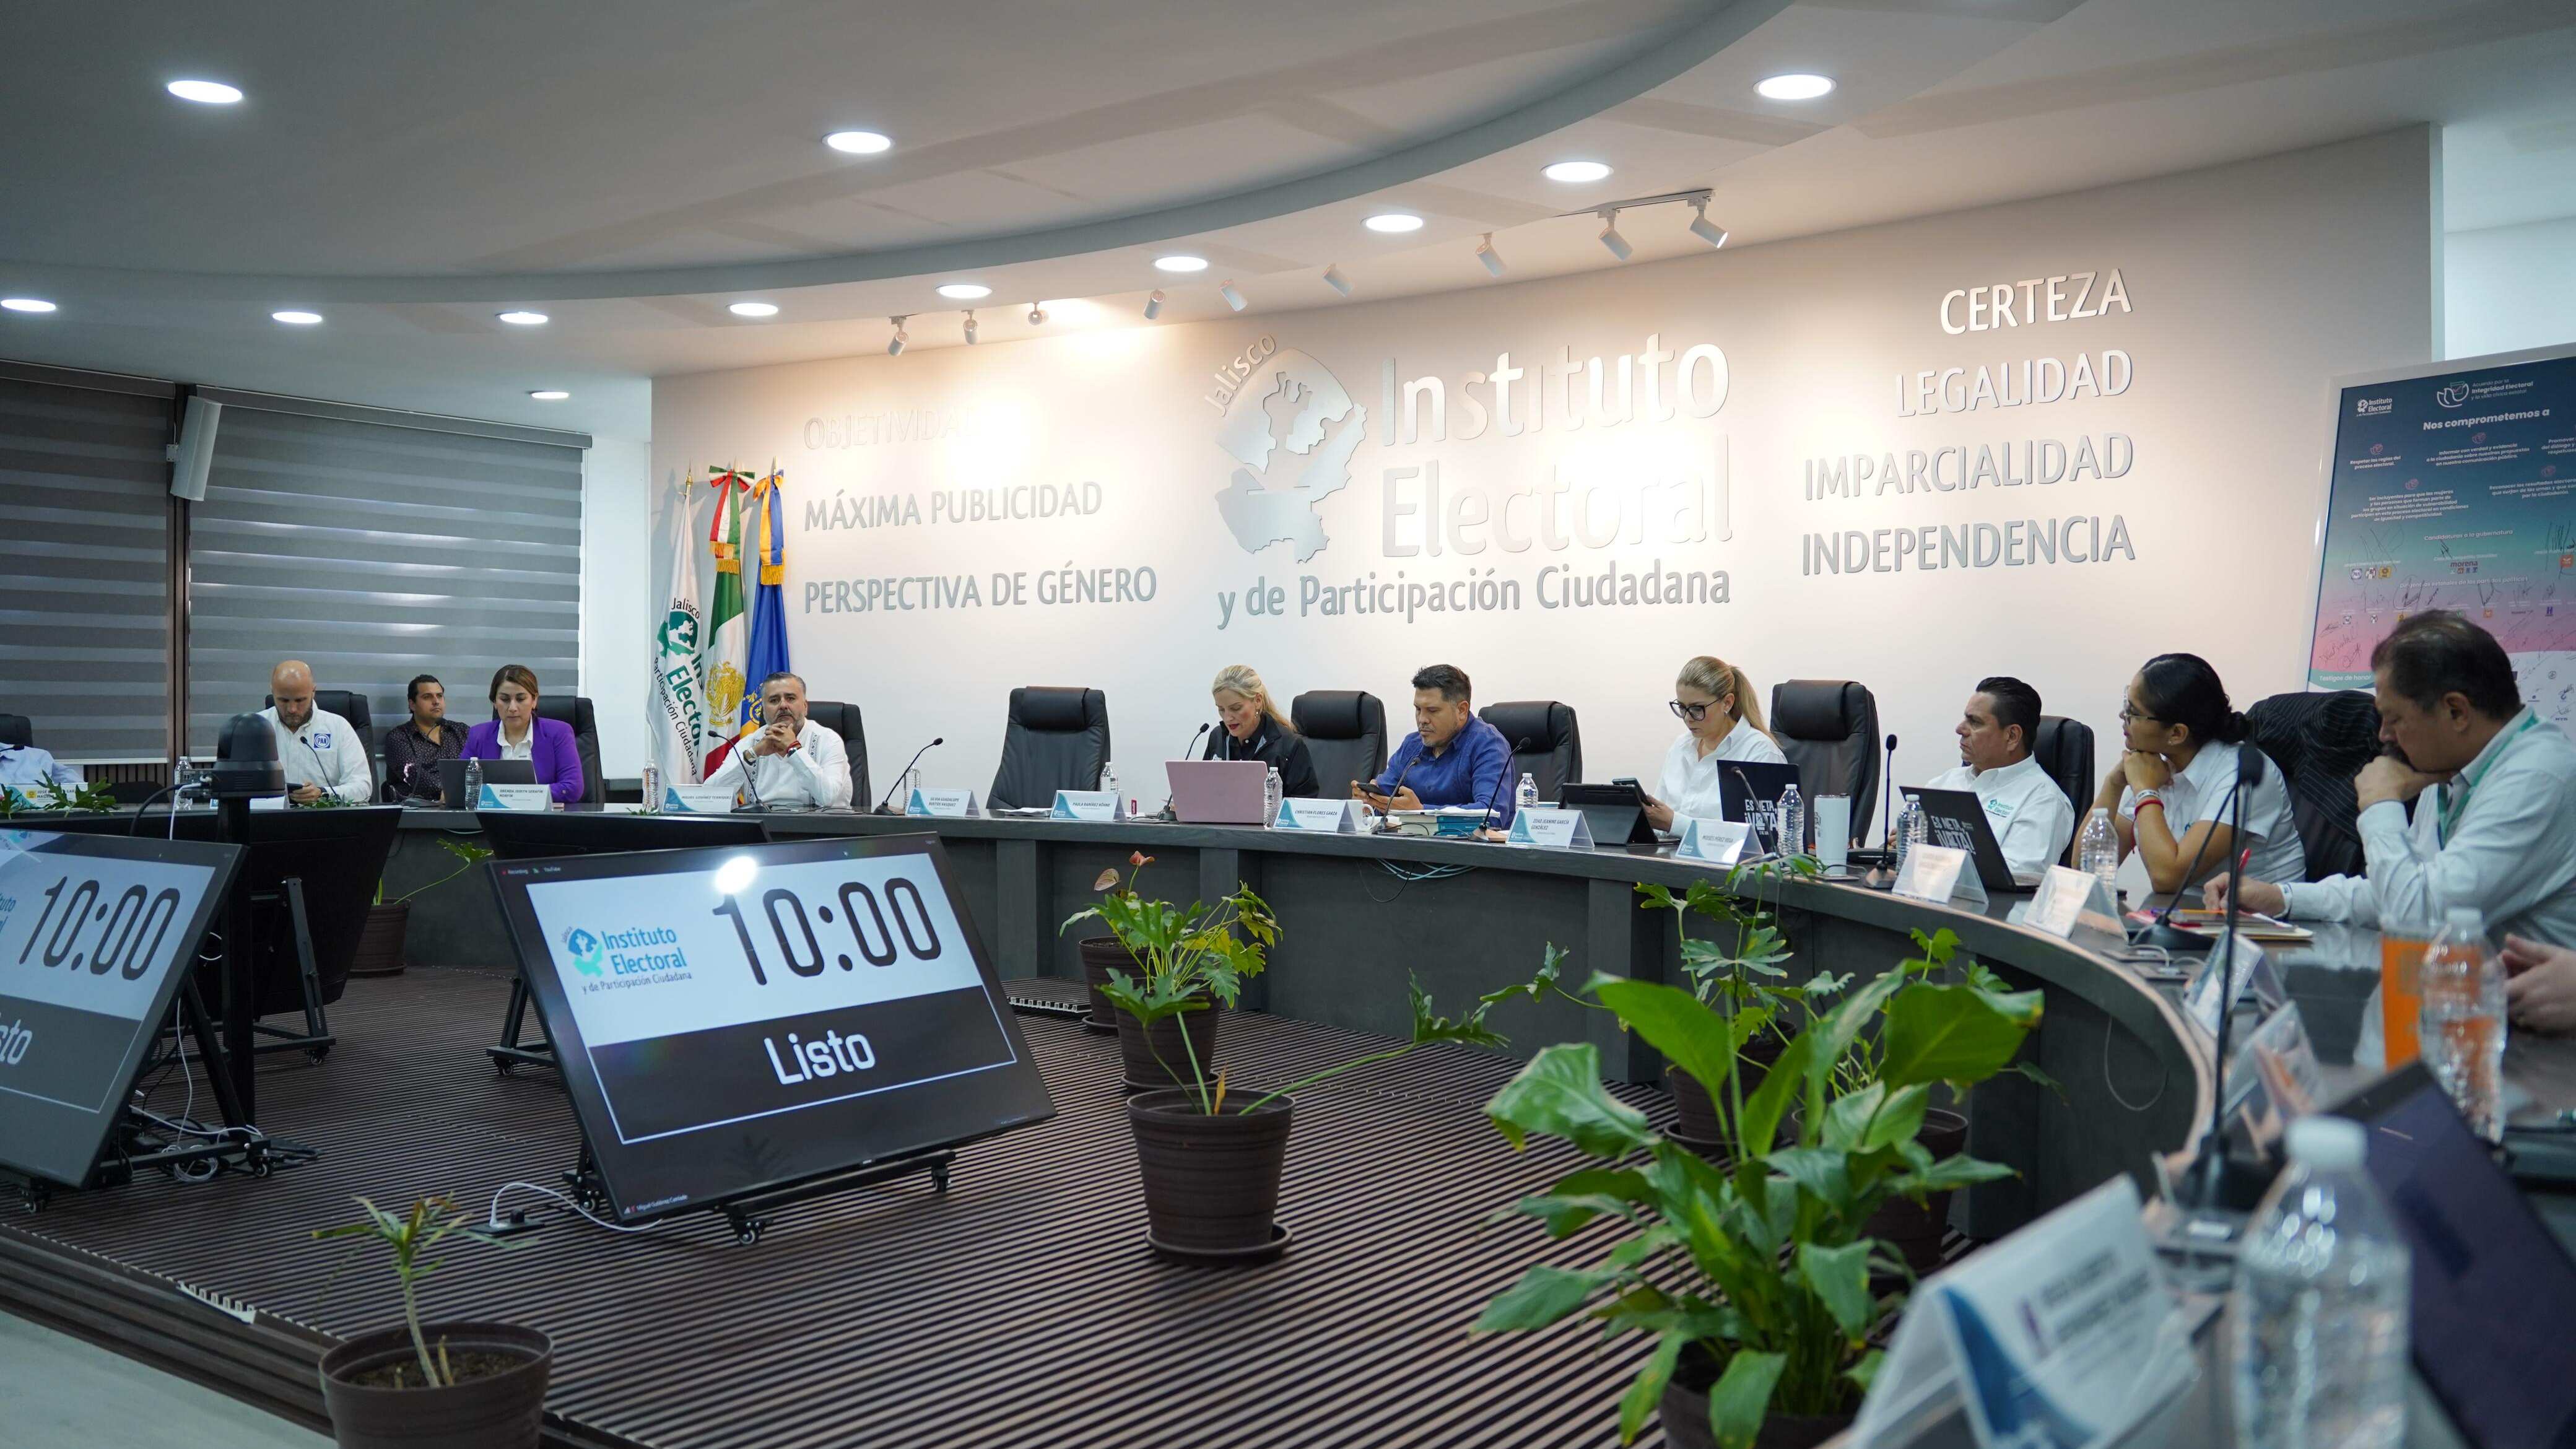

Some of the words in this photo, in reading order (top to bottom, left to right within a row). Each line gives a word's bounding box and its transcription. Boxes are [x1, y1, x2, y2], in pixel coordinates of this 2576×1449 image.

[1940, 268, 2133, 334] CERTEZA
[1204, 333, 1276, 417] Jalisco
[1382, 333, 1730, 446] Instituto
[1895, 350, 2133, 417] LEGALIDAD
[2472, 385, 2504, 394] Integridad
[2505, 381, 2533, 389] Electoral
[2368, 403, 2391, 412] Electoral
[2423, 422, 2443, 430] Nos
[2445, 411, 2540, 428] comprometemos
[2542, 408, 2550, 416] a
[1804, 432, 2133, 500] IMPARCIALIDAD
[806, 489, 921, 531] MÁXIMA
[931, 481, 1103, 524] PUBLICIDAD
[1382, 433, 1733, 557] Electoral
[1802, 515, 2135, 575] INDEPENDENCIA
[671, 598, 700, 620] Jalisco
[806, 575, 981, 613] PERSPECTIVA
[992, 572, 1027, 606] DE
[1037, 560, 1157, 604] GÉNERO
[1217, 590, 1237, 630] y
[1245, 576, 1284, 616] de
[1300, 567, 1521, 624] Participación
[1536, 559, 1731, 609] Ciudadana
[1744, 799, 1755, 812] ES
[1930, 815, 1943, 829] ES
[19, 876, 181, 980] 10:00
[600, 927, 677, 951] Instituto
[712, 877, 942, 986] 10:00
[588, 982, 599, 992] de
[599, 976, 651, 991] Participación
[651, 971, 692, 983] Ciudadana
[610, 947, 687, 975] Electoral
[764, 1030, 876, 1086] Listo
